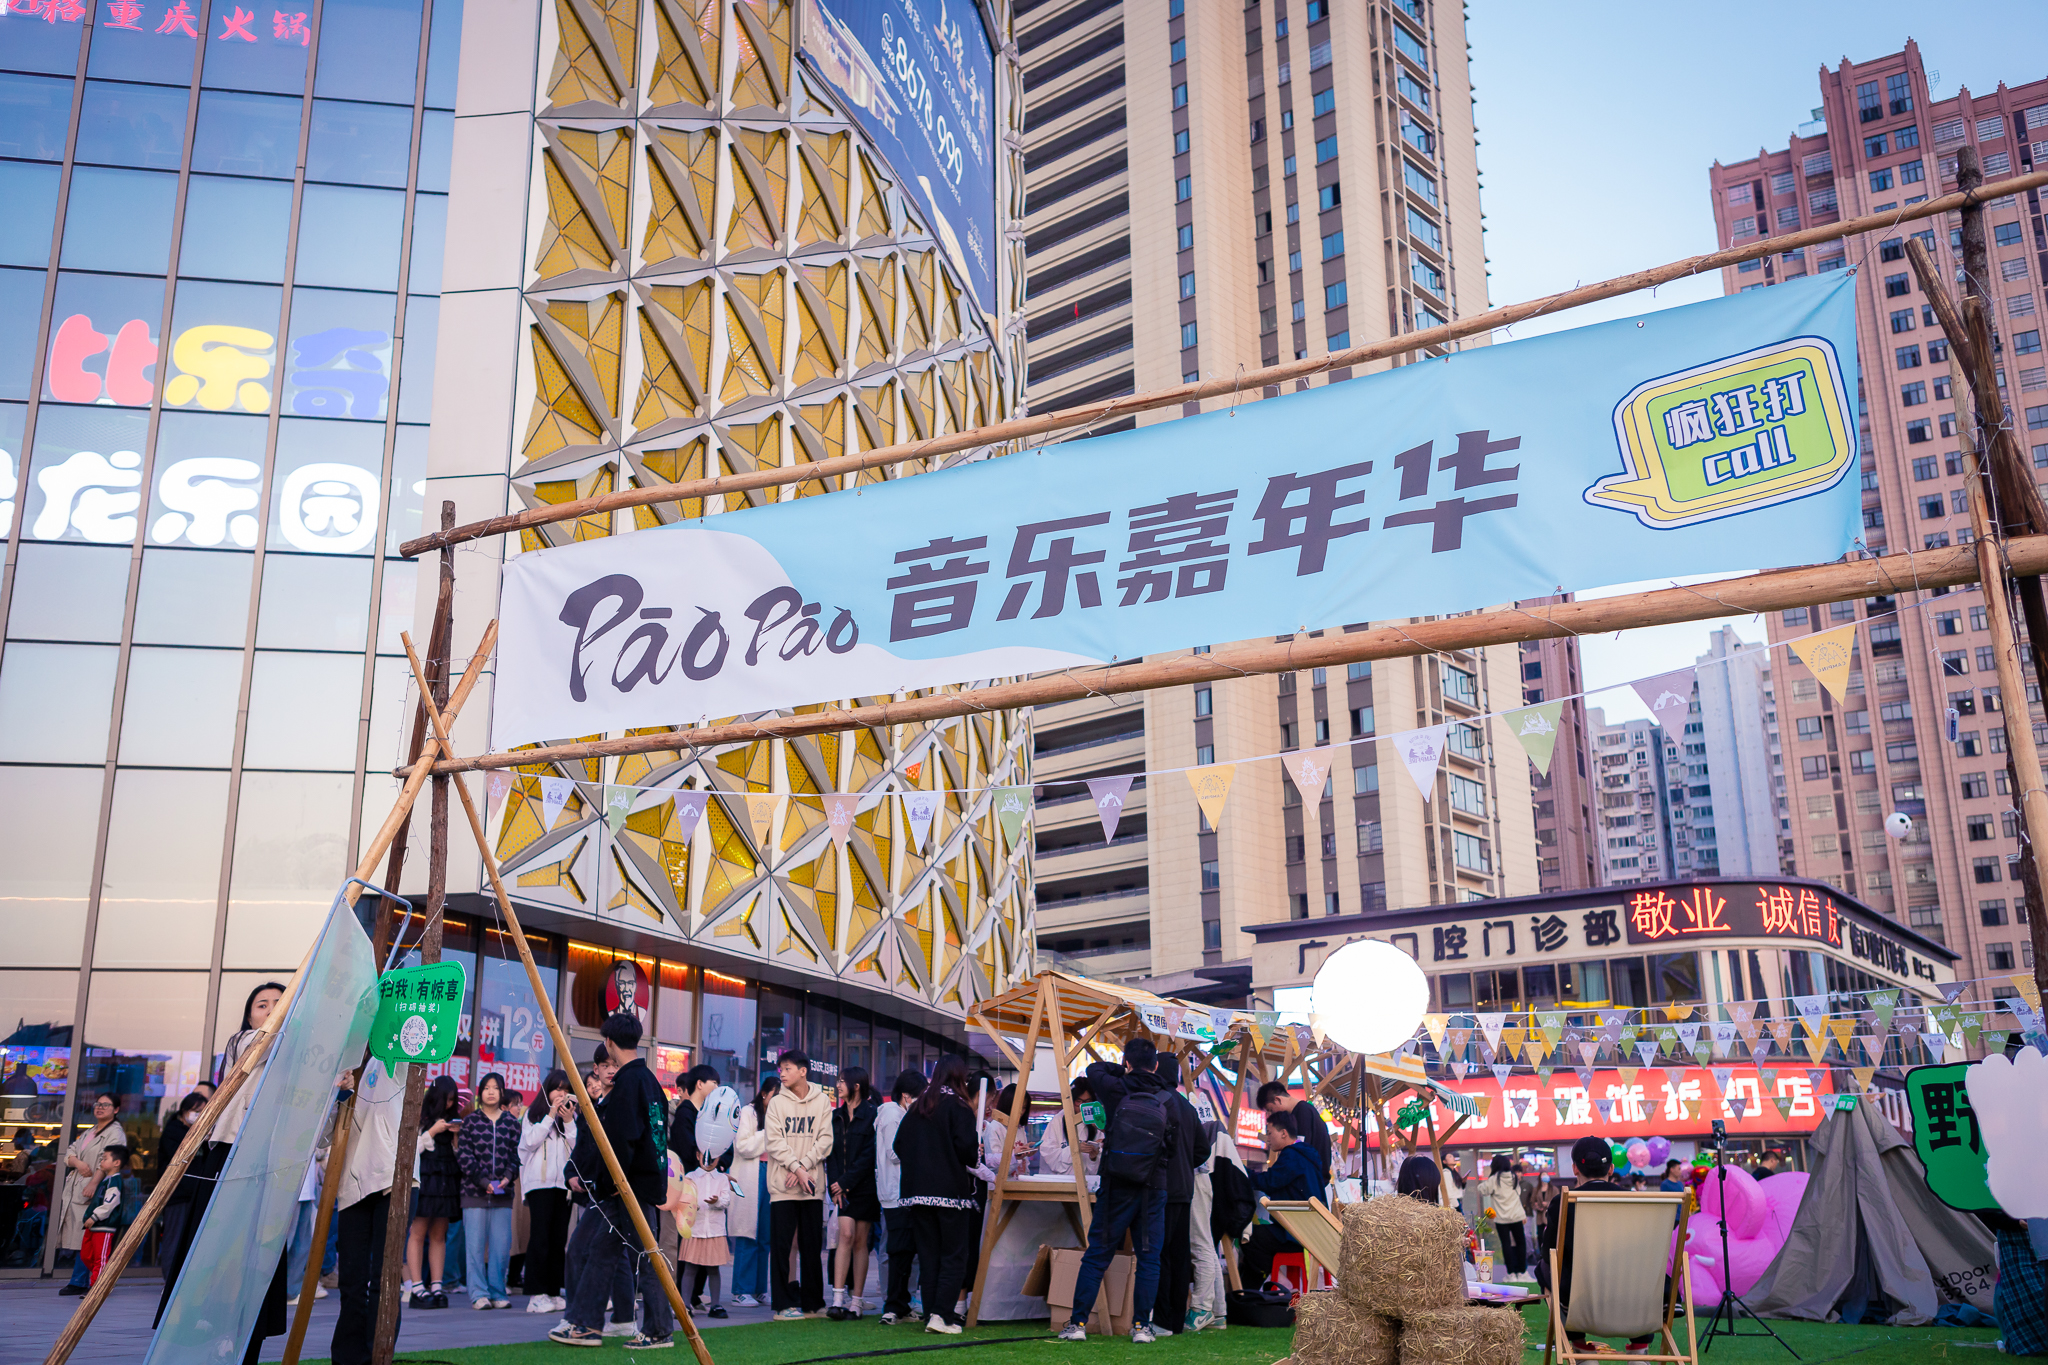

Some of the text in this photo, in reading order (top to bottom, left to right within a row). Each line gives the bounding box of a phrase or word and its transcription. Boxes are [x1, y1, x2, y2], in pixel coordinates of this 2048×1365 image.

[8, 0, 311, 46] 格重庆火锅
[49, 314, 389, 419] 比乐奇
[1663, 371, 1806, 450] 疯狂打
[1703, 424, 1796, 486] call
[0, 449, 426, 554] 龙乐园
[887, 429, 1522, 643] 音乐嘉年华
[1298, 909, 1621, 975] 广口腔门诊部
[1629, 887, 1732, 940] 敬业
[1146, 1013, 1196, 1035] 王朝国酒店
[1327, 1076, 1817, 1138] 品牌服饰折扣店
[1932, 1263, 1991, 1289] utDoor
